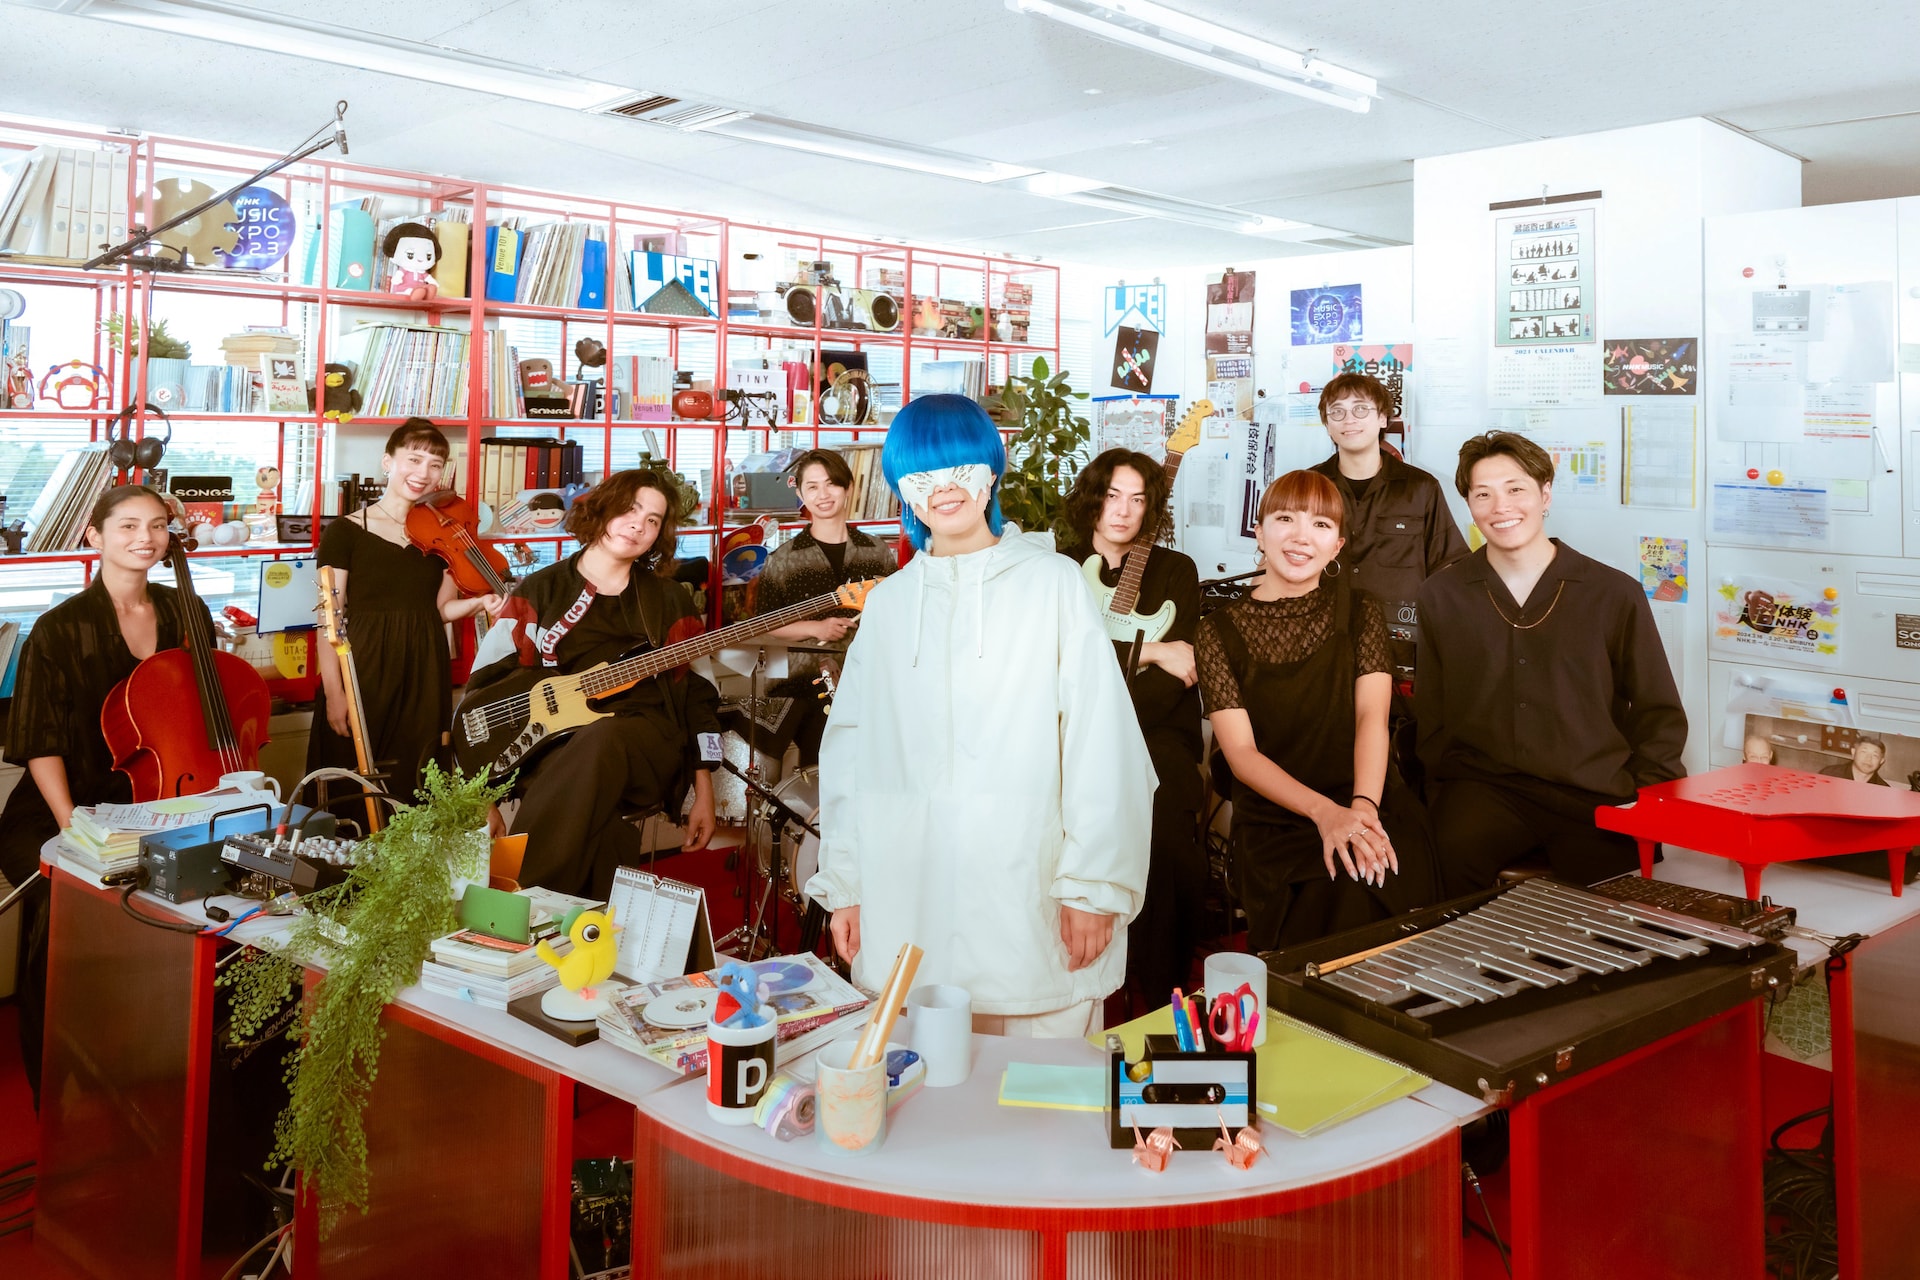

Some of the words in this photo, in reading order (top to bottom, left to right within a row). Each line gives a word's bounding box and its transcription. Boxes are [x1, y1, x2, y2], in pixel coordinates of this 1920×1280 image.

[236, 198, 260, 206] NHK
[237, 207, 280, 223] USIC
[227, 225, 280, 240] XPO
[498, 236, 507, 247] 101
[496, 248, 506, 271] Venue
[1313, 304, 1338, 313] MUSIC
[1313, 312, 1338, 321] EXPO
[737, 374, 769, 383] TINY
[633, 404, 653, 412] Venue
[654, 404, 664, 412] 101
[175, 489, 231, 497] SONGS
[564, 589, 594, 624] ACD
[1778, 605, 1813, 620] 体験
[1775, 619, 1808, 630] NHK
[541, 621, 568, 654] ACD
[737, 1058, 767, 1104] p
